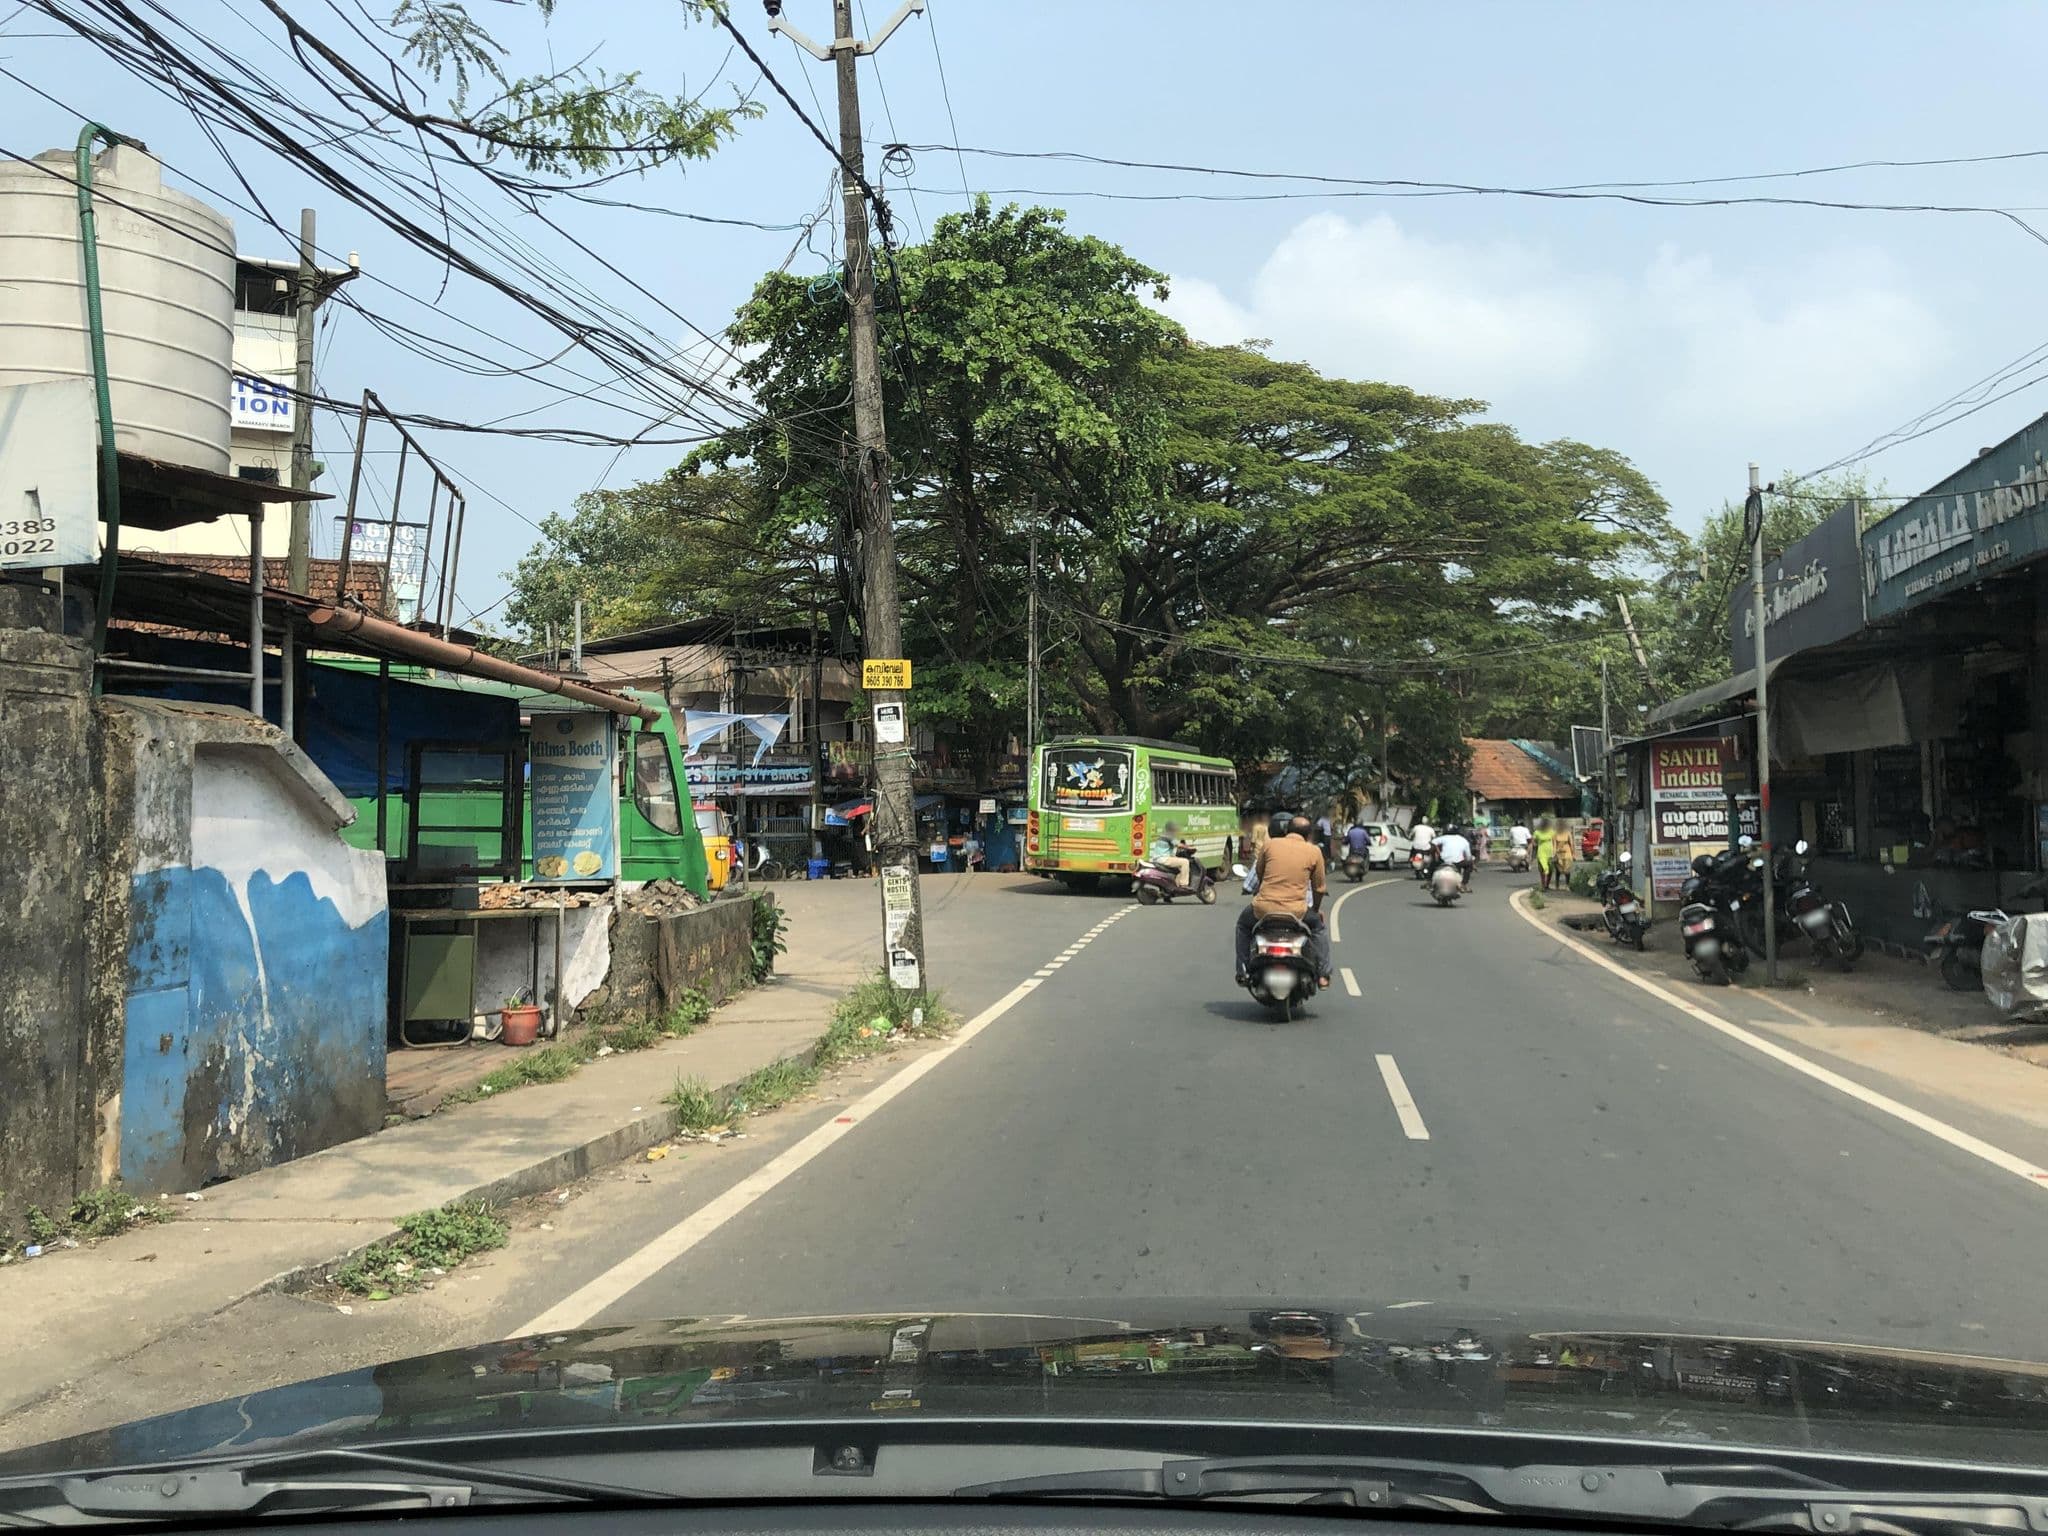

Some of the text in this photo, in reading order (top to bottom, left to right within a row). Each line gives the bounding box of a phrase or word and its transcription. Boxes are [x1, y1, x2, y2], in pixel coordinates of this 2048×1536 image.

[0, 518, 56, 536] 383
[0, 538, 55, 556] 022
[568, 739, 603, 757] Booth
[1660, 746, 1720, 768] SANTH
